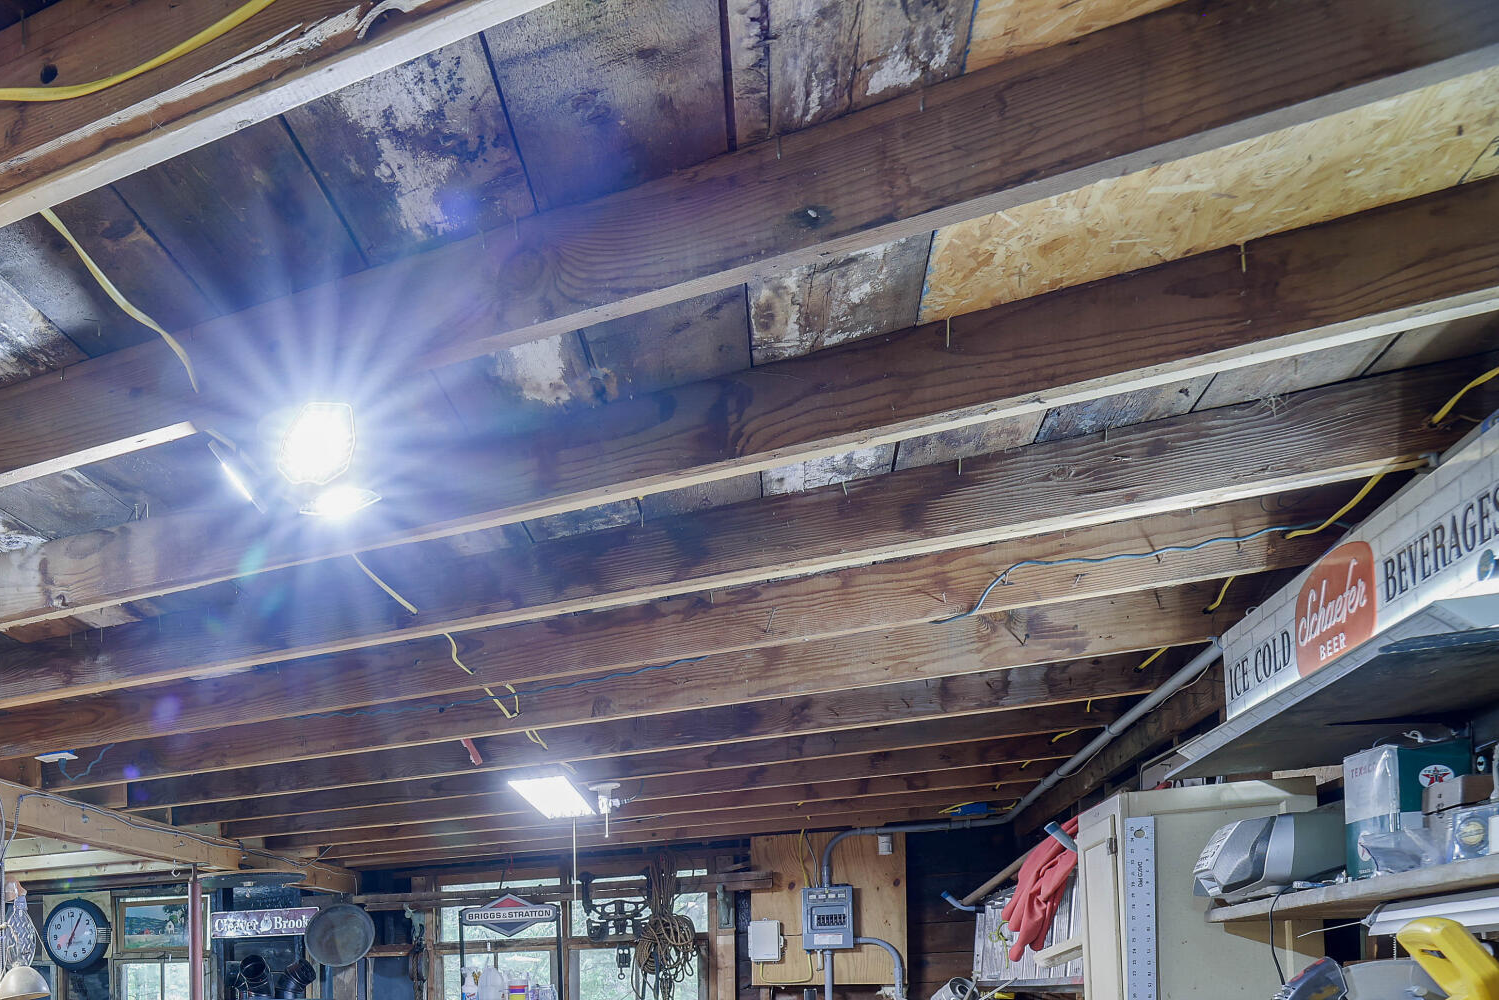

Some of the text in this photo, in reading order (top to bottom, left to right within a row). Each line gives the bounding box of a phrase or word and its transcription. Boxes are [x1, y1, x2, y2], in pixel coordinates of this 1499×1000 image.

[1299, 558, 1368, 647] Schaefer
[1229, 630, 1291, 701] ICE COLD
[1319, 632, 1347, 661] BEER
